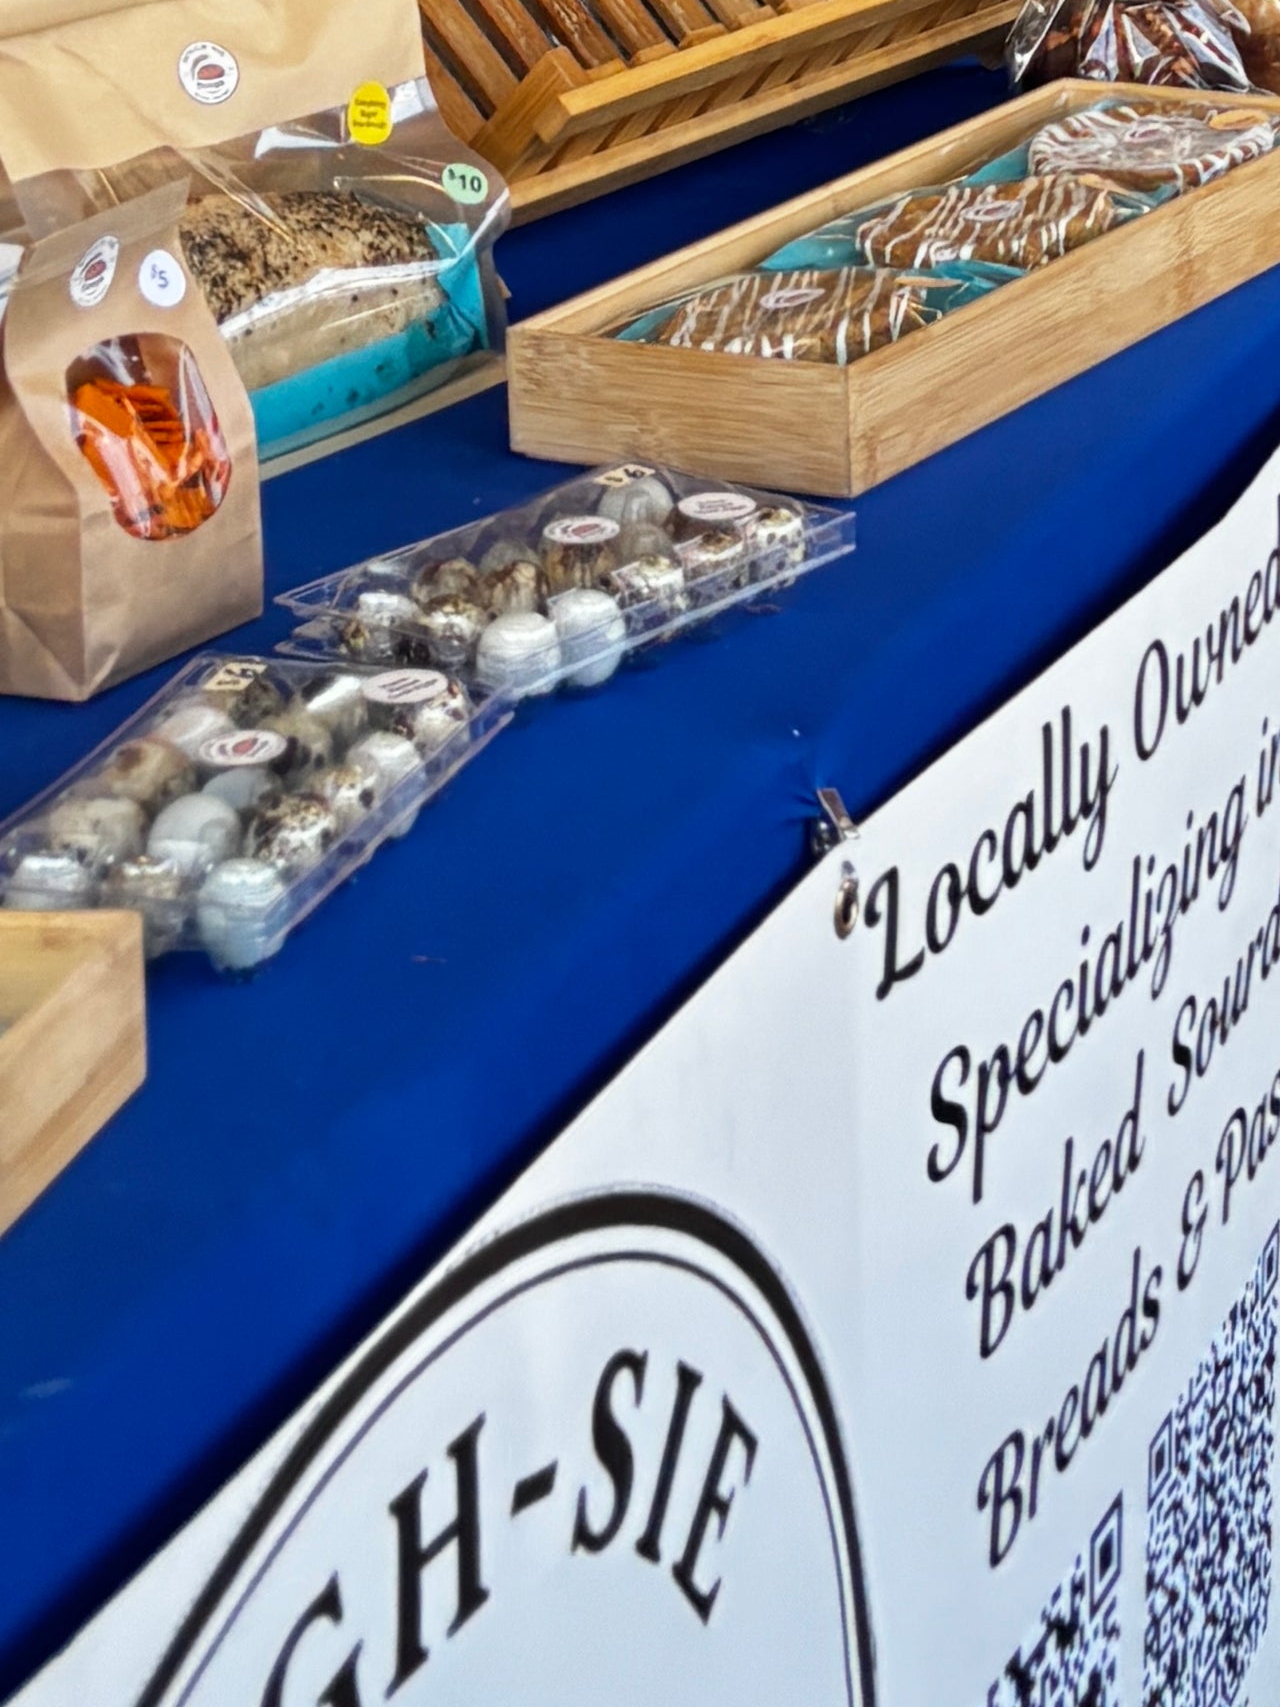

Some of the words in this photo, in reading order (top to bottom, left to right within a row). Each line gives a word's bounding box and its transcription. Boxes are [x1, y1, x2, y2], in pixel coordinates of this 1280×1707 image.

[863, 704, 1119, 1002] Locally
[926, 774, 1250, 1206] Specializing
[965, 1048, 1147, 1360] Baked
[977, 1245, 1164, 1571] Breads
[1177, 1168, 1209, 1292] &
